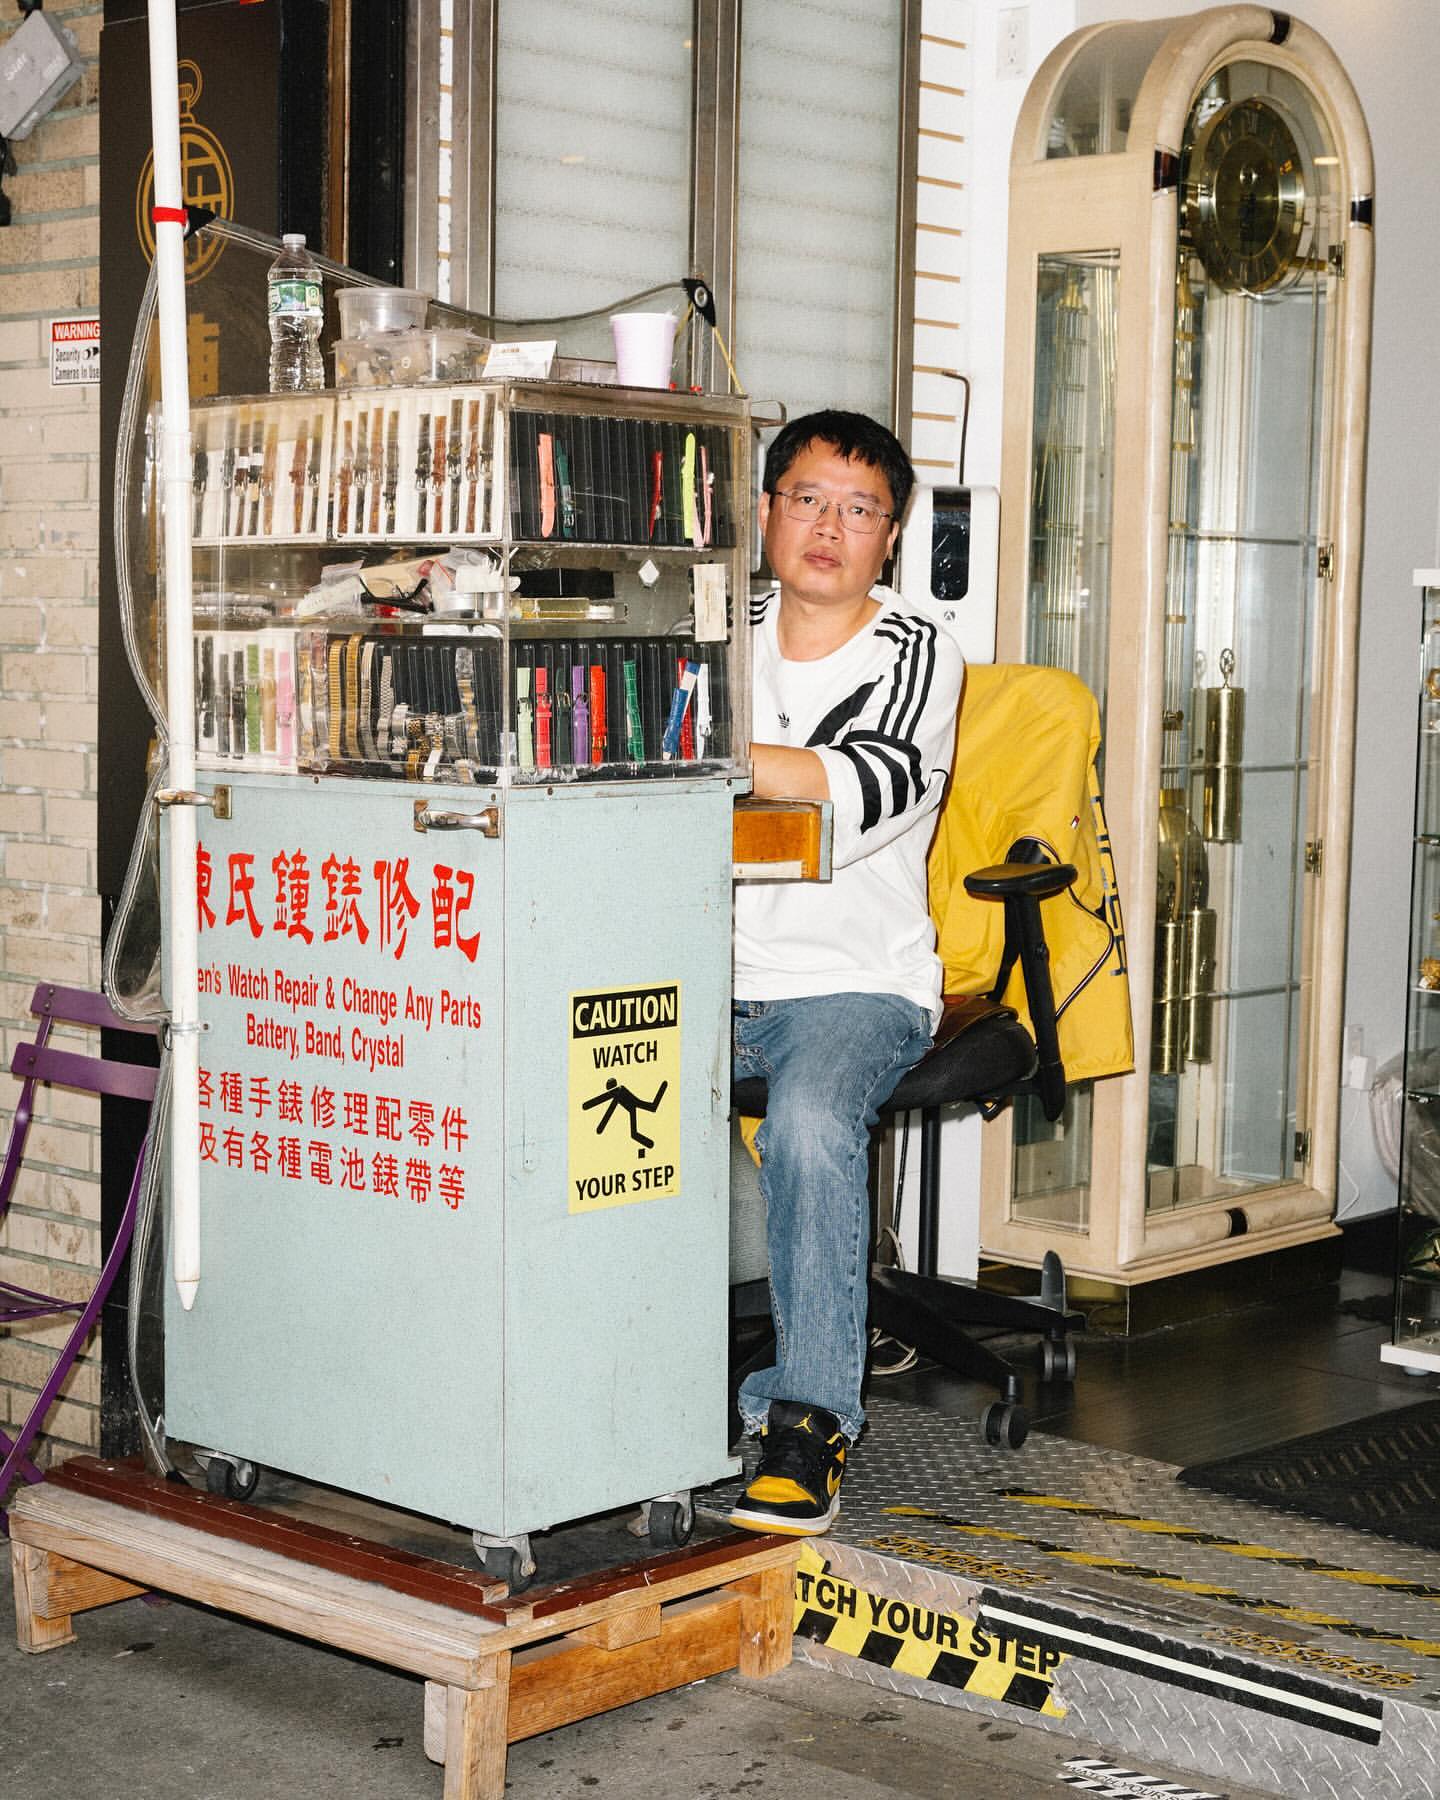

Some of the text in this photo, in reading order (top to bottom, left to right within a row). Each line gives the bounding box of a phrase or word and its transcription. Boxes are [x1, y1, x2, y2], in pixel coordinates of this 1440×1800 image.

[54, 322, 100, 340] WARNING
[55, 366, 79, 380] Cameras
[89, 365, 100, 379] Use
[56, 348, 80, 364] Security
[197, 962, 481, 1031] en's Watch Repair & Change Any Parts
[574, 992, 675, 1032] CAUTION
[246, 1012, 405, 1073] Battery, Band, Crystal
[593, 1039, 658, 1069] WATCH
[575, 1165, 674, 1201] YOUR STEP
[794, 1570, 1061, 1675] TCH YOUR STEP
